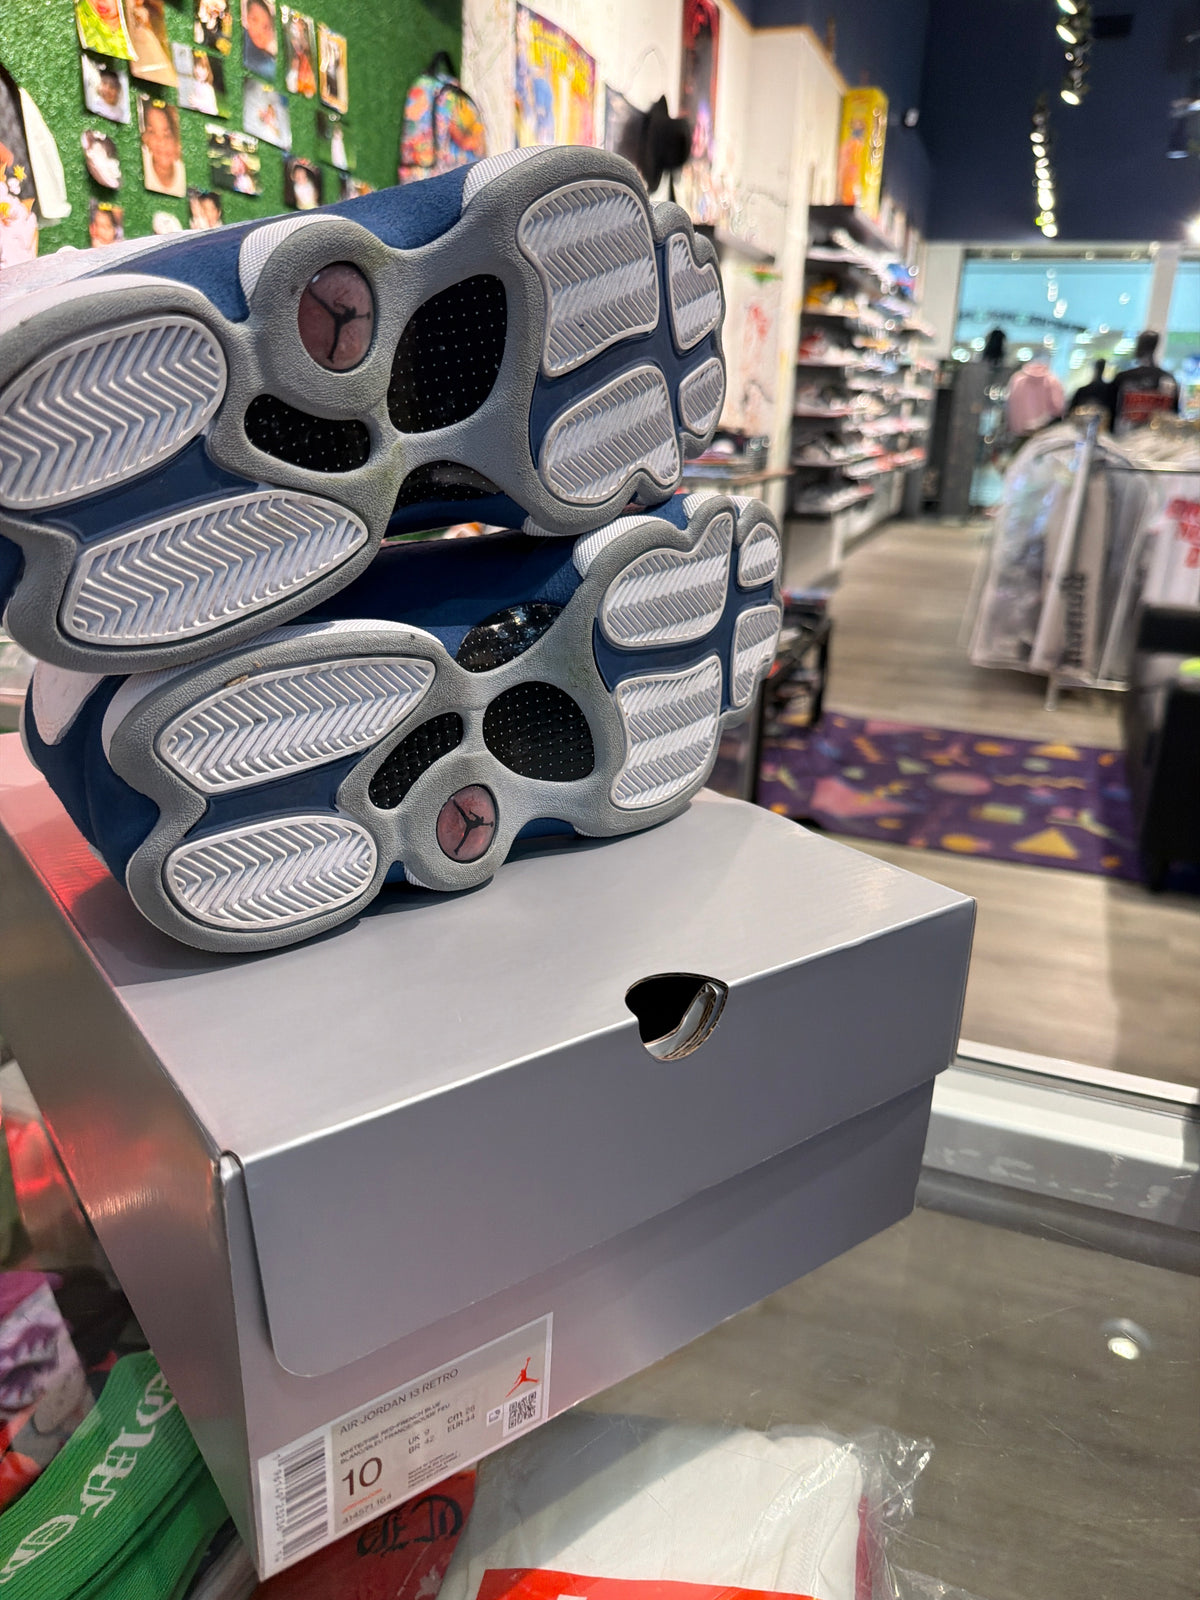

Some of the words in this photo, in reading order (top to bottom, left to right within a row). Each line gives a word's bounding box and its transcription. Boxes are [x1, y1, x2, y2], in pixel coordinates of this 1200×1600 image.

[340, 1420, 358, 1434] AIR
[361, 1395, 406, 1424] JORDAN
[409, 1387, 420, 1399] 13
[422, 1368, 458, 1392] RETRO
[447, 1411, 462, 1424] cm
[447, 1420, 463, 1433] EUR
[465, 1413, 475, 1423] 44
[408, 1434, 420, 1445] UK
[342, 1456, 382, 1496] 10
